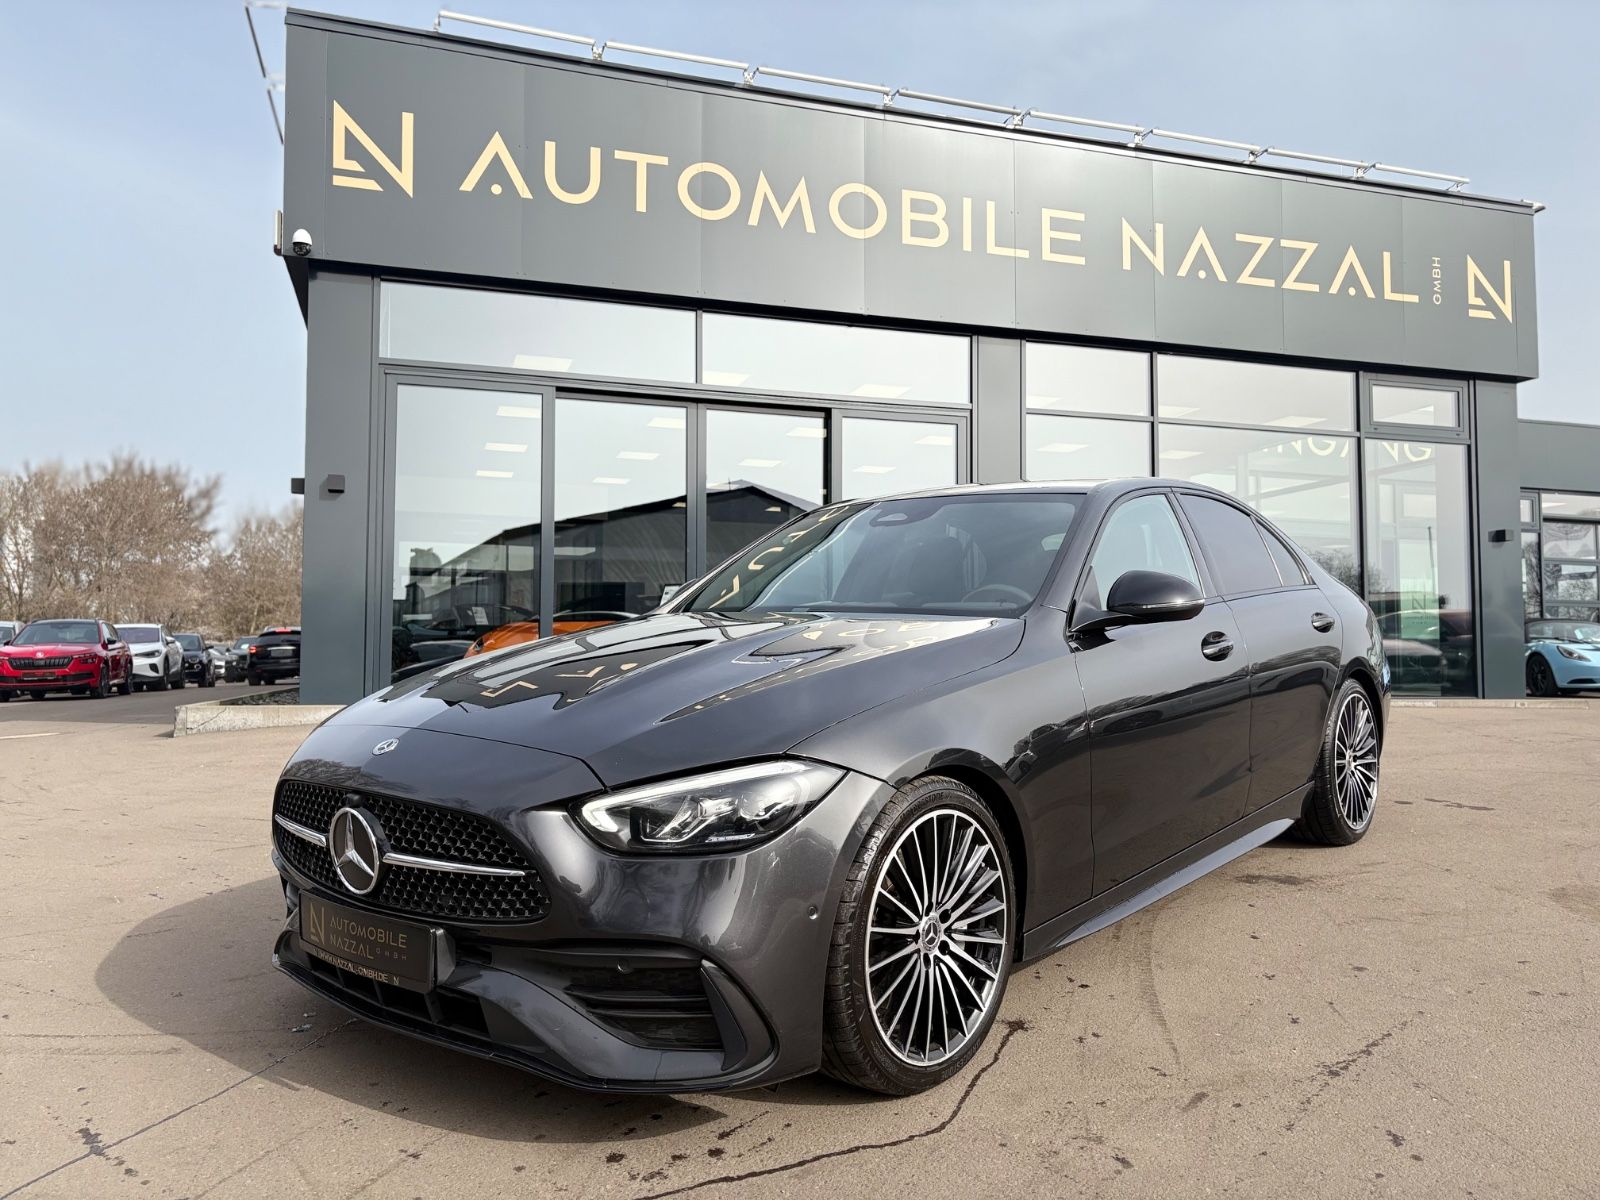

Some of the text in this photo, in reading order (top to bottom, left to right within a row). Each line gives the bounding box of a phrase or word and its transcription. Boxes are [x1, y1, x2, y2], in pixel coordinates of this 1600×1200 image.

[458, 130, 1086, 266] AUTOMOBILE
[1121, 216, 1420, 304] NAZZAL
[1431, 255, 1442, 305] GMBH
[329, 915, 408, 948] AUTOMOBILE
[330, 933, 374, 959] NAZZAL
